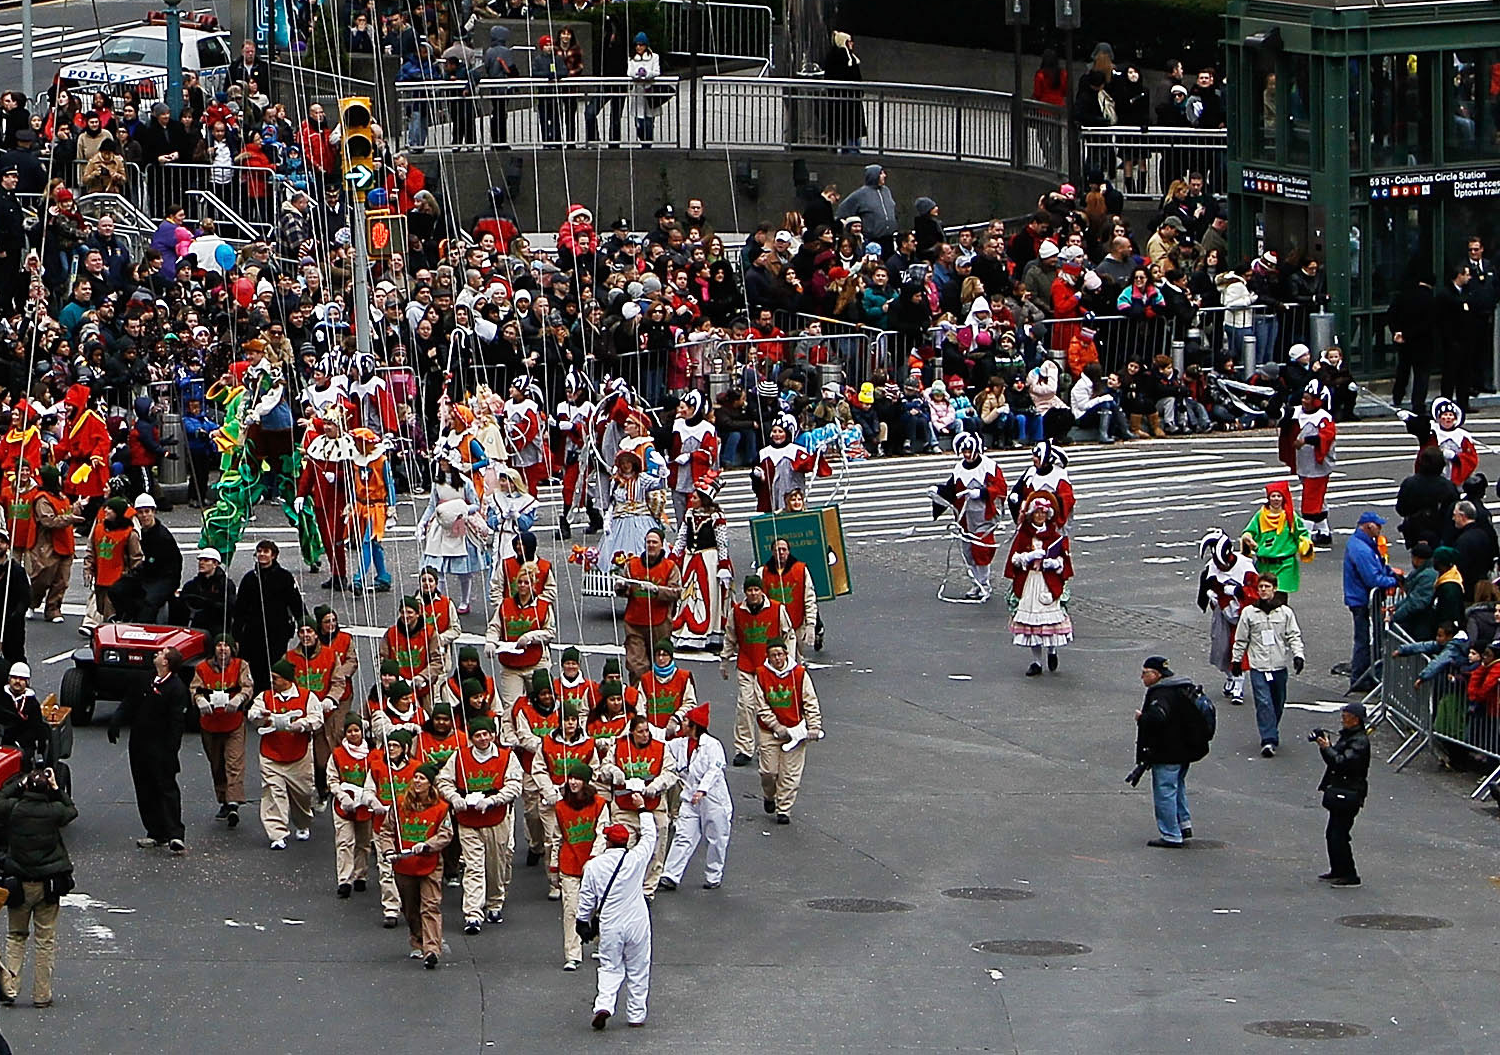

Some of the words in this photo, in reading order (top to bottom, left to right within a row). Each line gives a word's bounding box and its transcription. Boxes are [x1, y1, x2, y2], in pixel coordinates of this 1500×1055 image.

[1370, 177, 1380, 186] 59
[1381, 177, 1390, 185] St
[1395, 175, 1433, 184] Columbus
[1435, 173, 1457, 181] Circle
[1459, 171, 1486, 180] Station
[1454, 189, 1483, 198] Uptown
